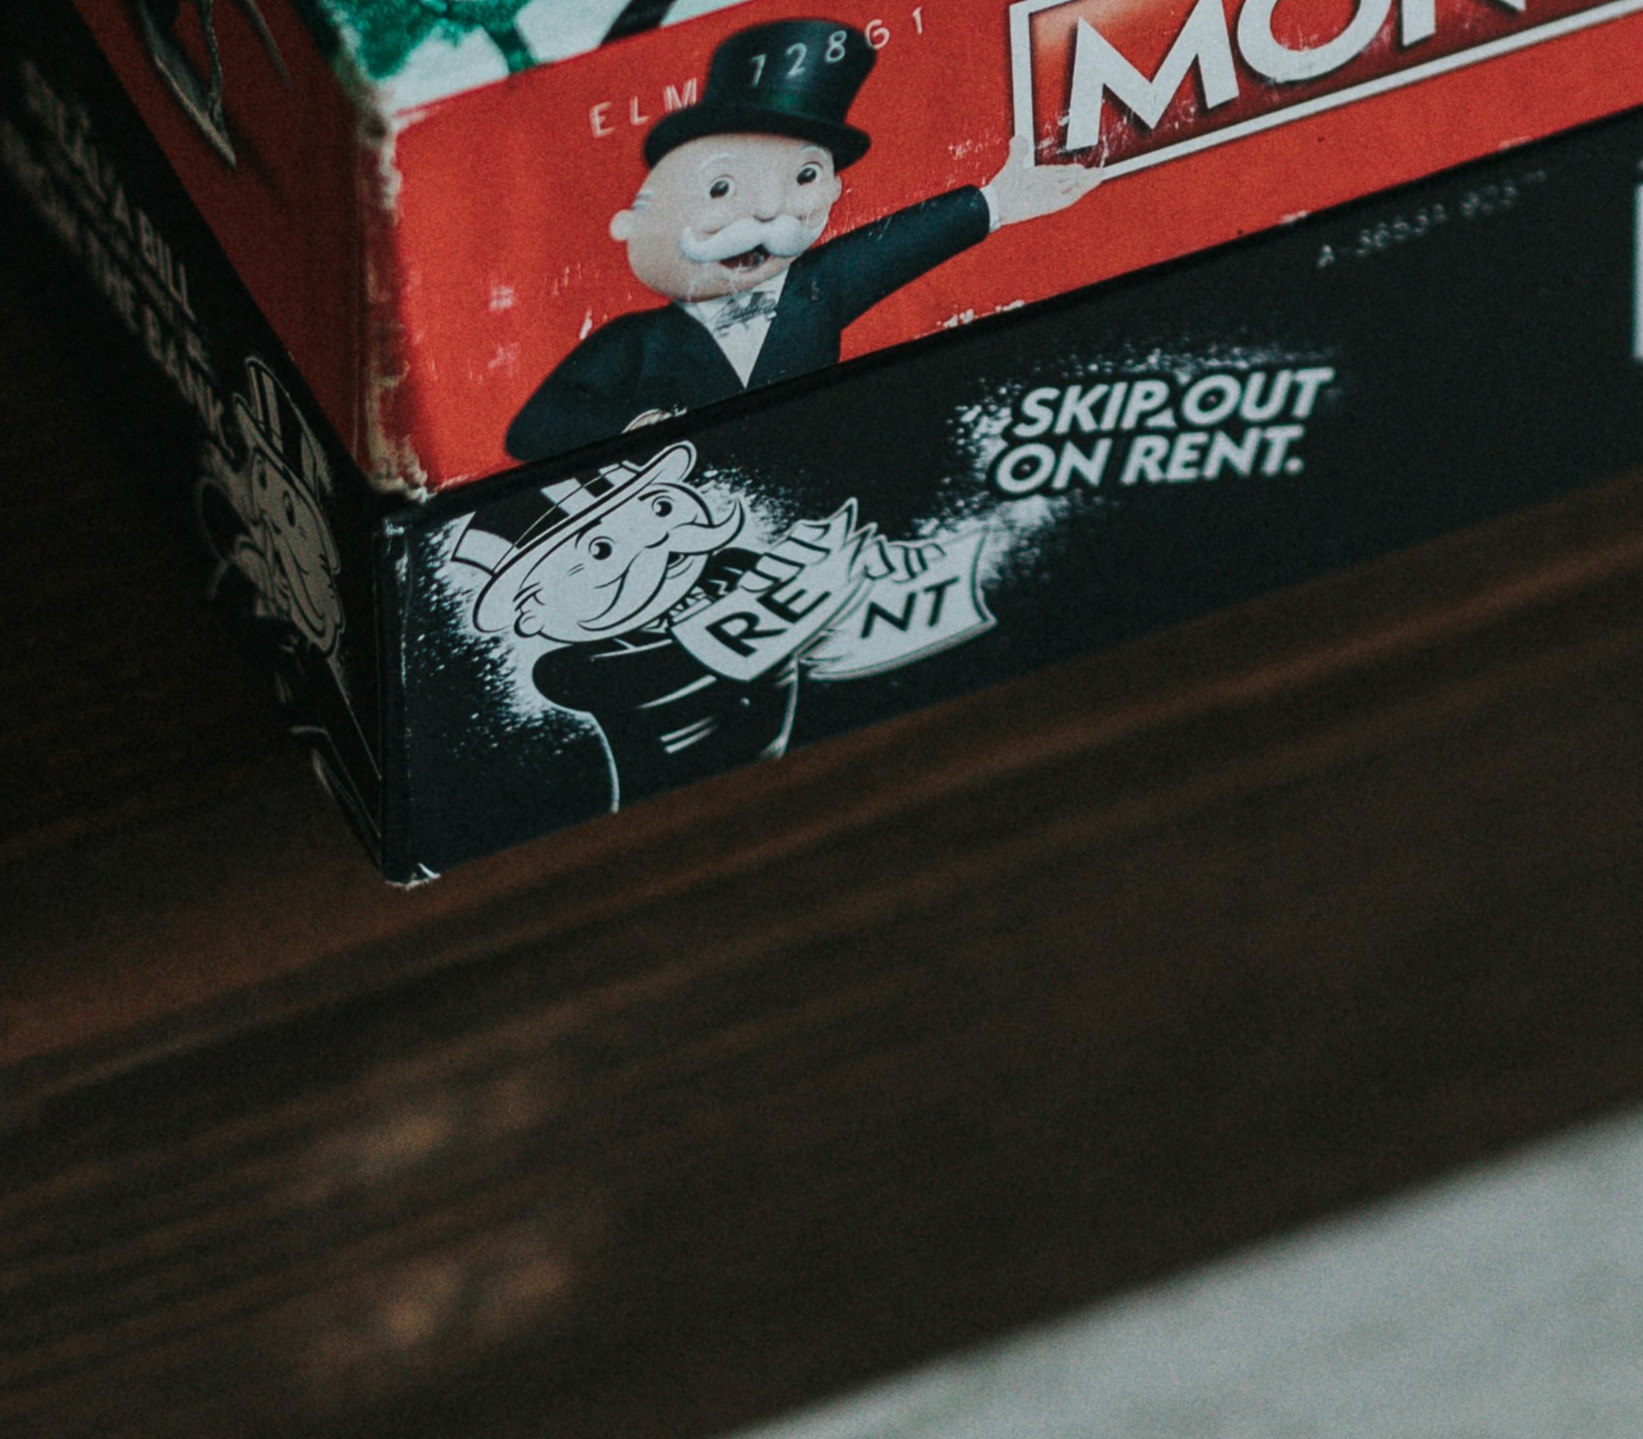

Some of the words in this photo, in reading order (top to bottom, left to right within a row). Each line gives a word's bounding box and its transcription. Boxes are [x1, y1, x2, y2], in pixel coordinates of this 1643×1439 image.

[1018, 380, 1167, 434] SKIP
[1180, 365, 1335, 426] OUT
[994, 436, 1113, 495] ON
[1123, 424, 1306, 485] RENT.
[708, 573, 827, 660] RE
[860, 576, 961, 641] NT
